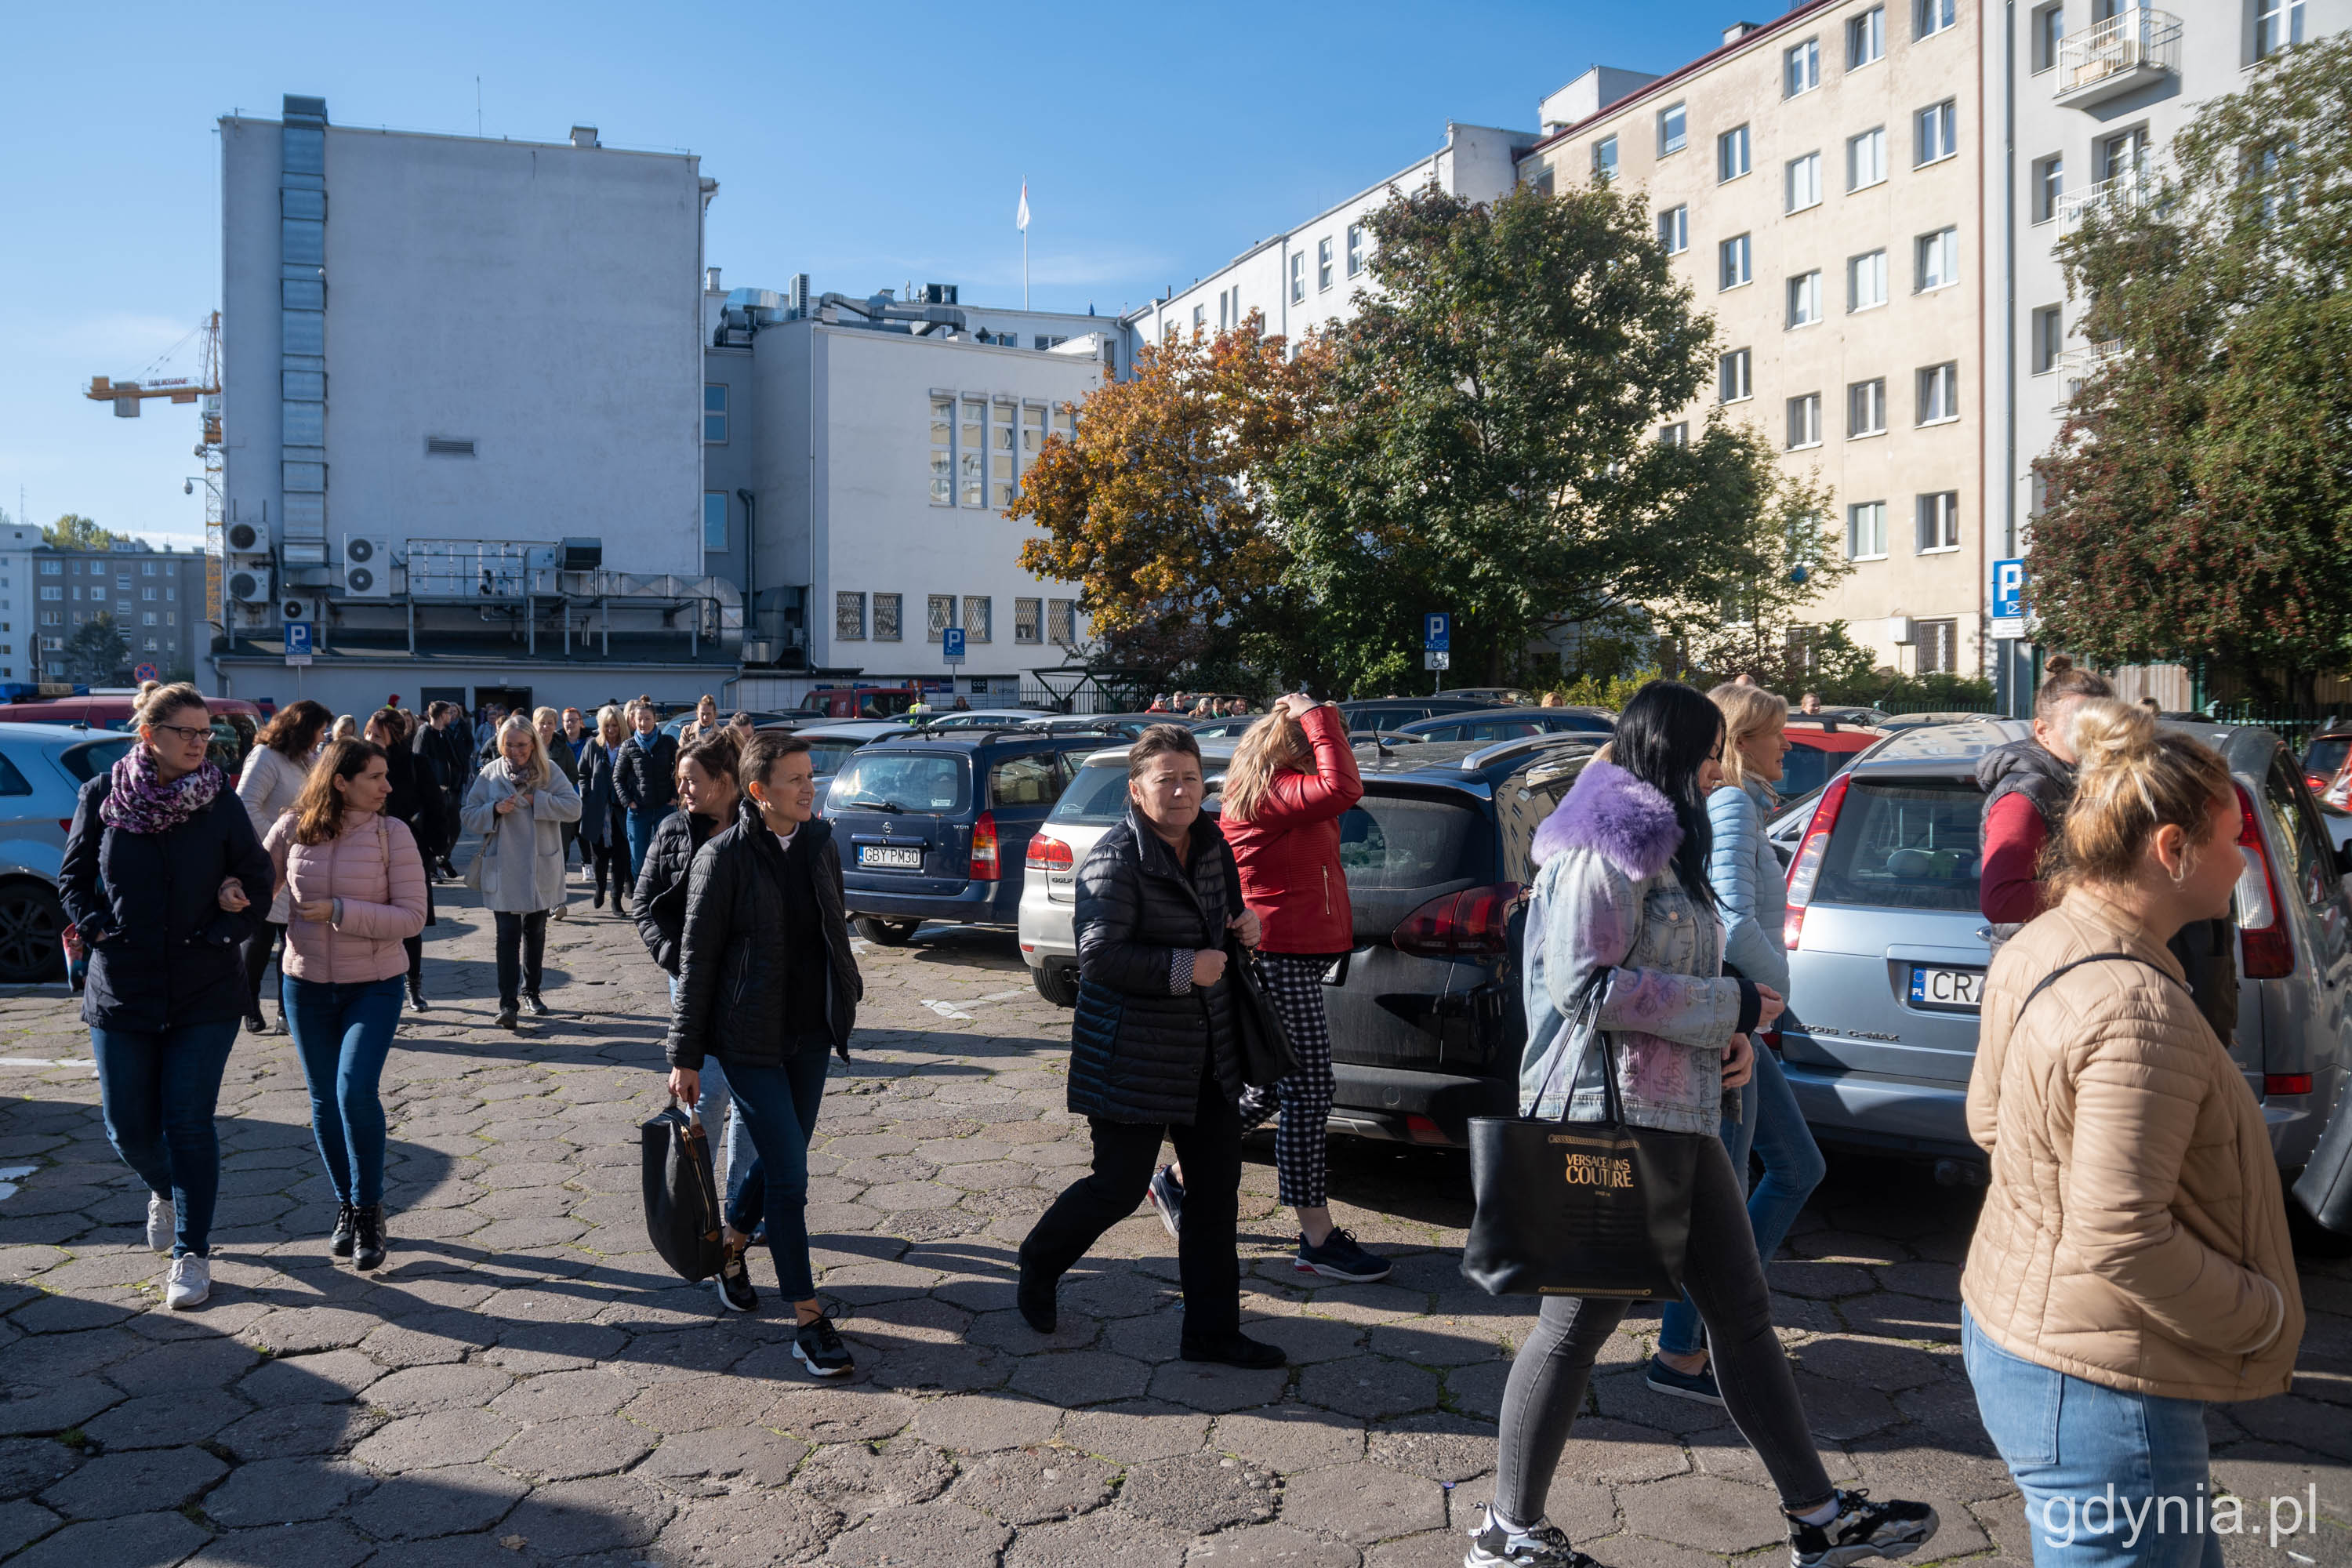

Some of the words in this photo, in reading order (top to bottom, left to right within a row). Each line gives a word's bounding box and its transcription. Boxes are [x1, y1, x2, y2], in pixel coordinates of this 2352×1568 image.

[1999, 564, 2023, 602] P
[291, 626, 306, 647] P
[949, 630, 960, 648] P
[1431, 617, 1444, 641] P
[865, 848, 887, 862] GBY
[891, 849, 919, 864] PM30
[1913, 988, 1924, 996] PL
[1933, 971, 1980, 1003] CR
[1793, 1022, 1840, 1036] FOCUS
[1847, 1029, 1901, 1043] C-MAX
[1566, 1153, 1606, 1168] VERSACE
[1566, 1165, 1635, 1188] COUTURE
